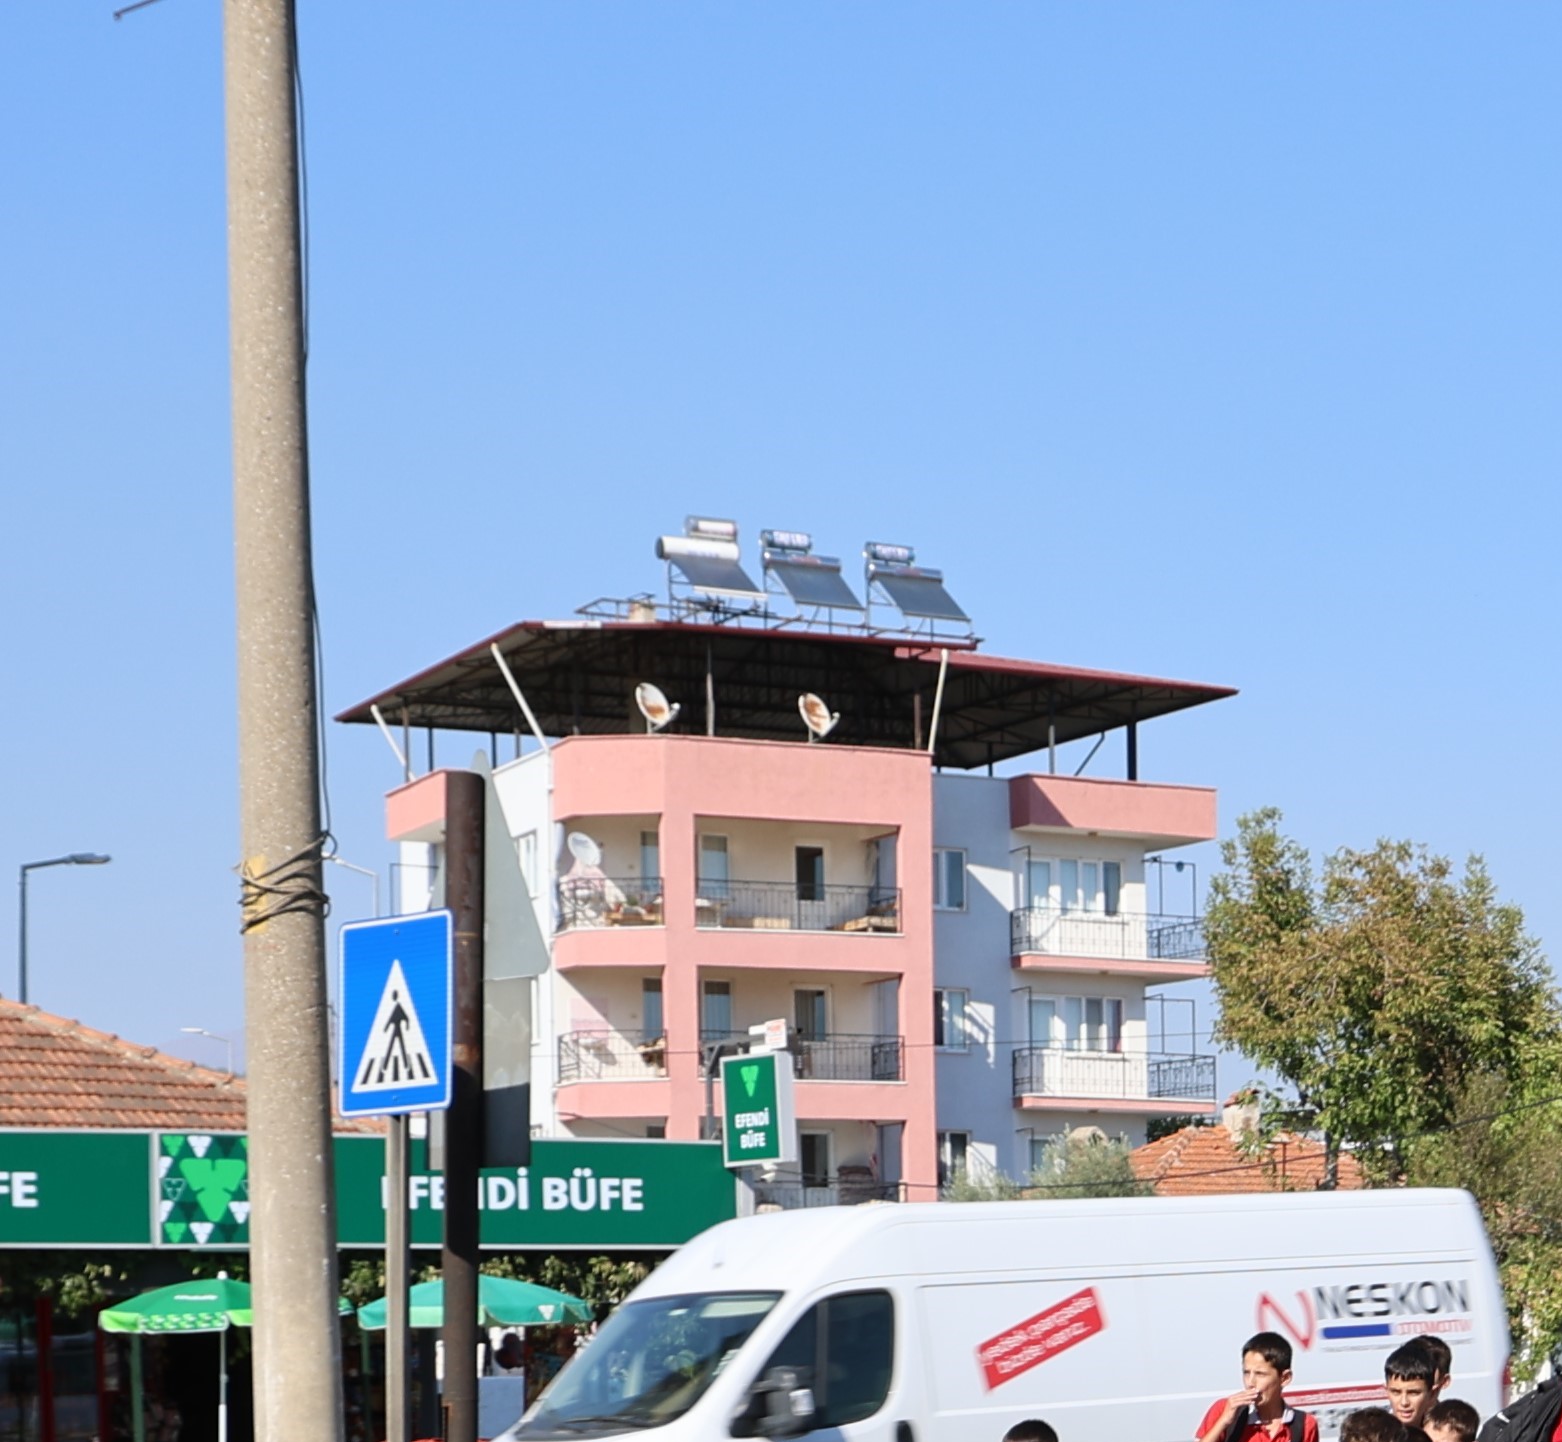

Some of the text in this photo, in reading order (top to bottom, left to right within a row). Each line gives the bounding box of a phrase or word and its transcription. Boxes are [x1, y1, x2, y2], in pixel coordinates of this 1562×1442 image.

[735, 1107, 769, 1129] EFENDİ
[740, 1129, 766, 1149] BÜFE
[542, 1168, 643, 1211] BÜFE
[1313, 1279, 1471, 1320] NESKON
